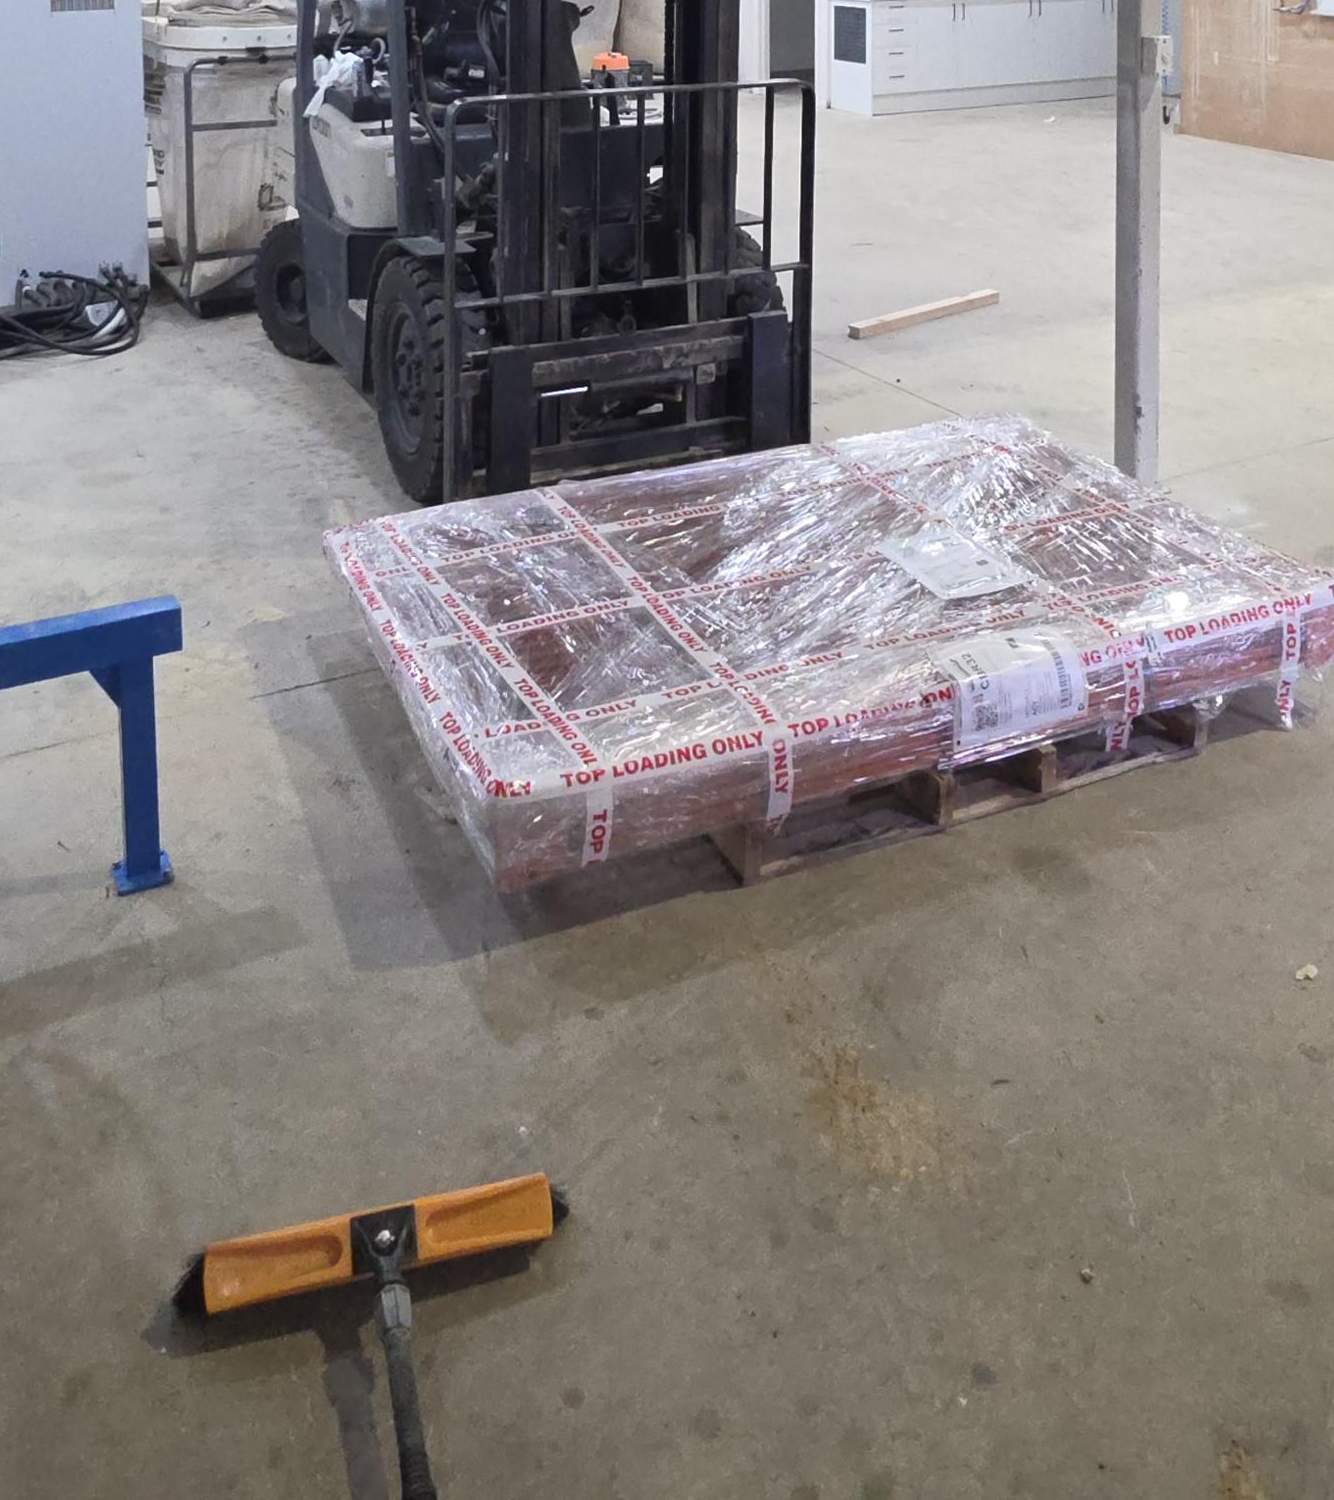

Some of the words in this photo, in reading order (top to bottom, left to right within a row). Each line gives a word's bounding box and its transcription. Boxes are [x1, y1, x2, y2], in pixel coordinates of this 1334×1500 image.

[619, 518, 647, 528] TOP
[442, 551, 476, 562] TOP
[479, 535, 554, 554] LOADING
[441, 593, 461, 612] TOP
[453, 609, 492, 646] LOADING
[486, 646, 515, 669] ONLY
[496, 610, 579, 633] LOADING
[584, 600, 629, 614] ONLY
[627, 576, 649, 594] TOP
[642, 592, 683, 632] LOADING
[679, 630, 708, 654] ONLY
[1164, 626, 1197, 644] TOP
[1200, 604, 1269, 636] LOADING
[1285, 622, 1297, 661] TOP
[485, 713, 580, 739] LOADG
[585, 699, 637, 717] ONLY
[660, 684, 703, 699] TOP
[864, 638, 900, 650] TOP
[709, 662, 735, 680] TOP
[439, 711, 463, 735] TOP
[514, 678, 538, 703] TOP
[531, 699, 577, 744] LOADING
[571, 742, 598, 766] ONL
[560, 768, 606, 788] TOP
[612, 742, 708, 779] LOADING
[711, 730, 764, 756] ONLY
[787, 717, 829, 738] TOP
[772, 738, 789, 795] ONLY
[591, 808, 608, 854] TOP
